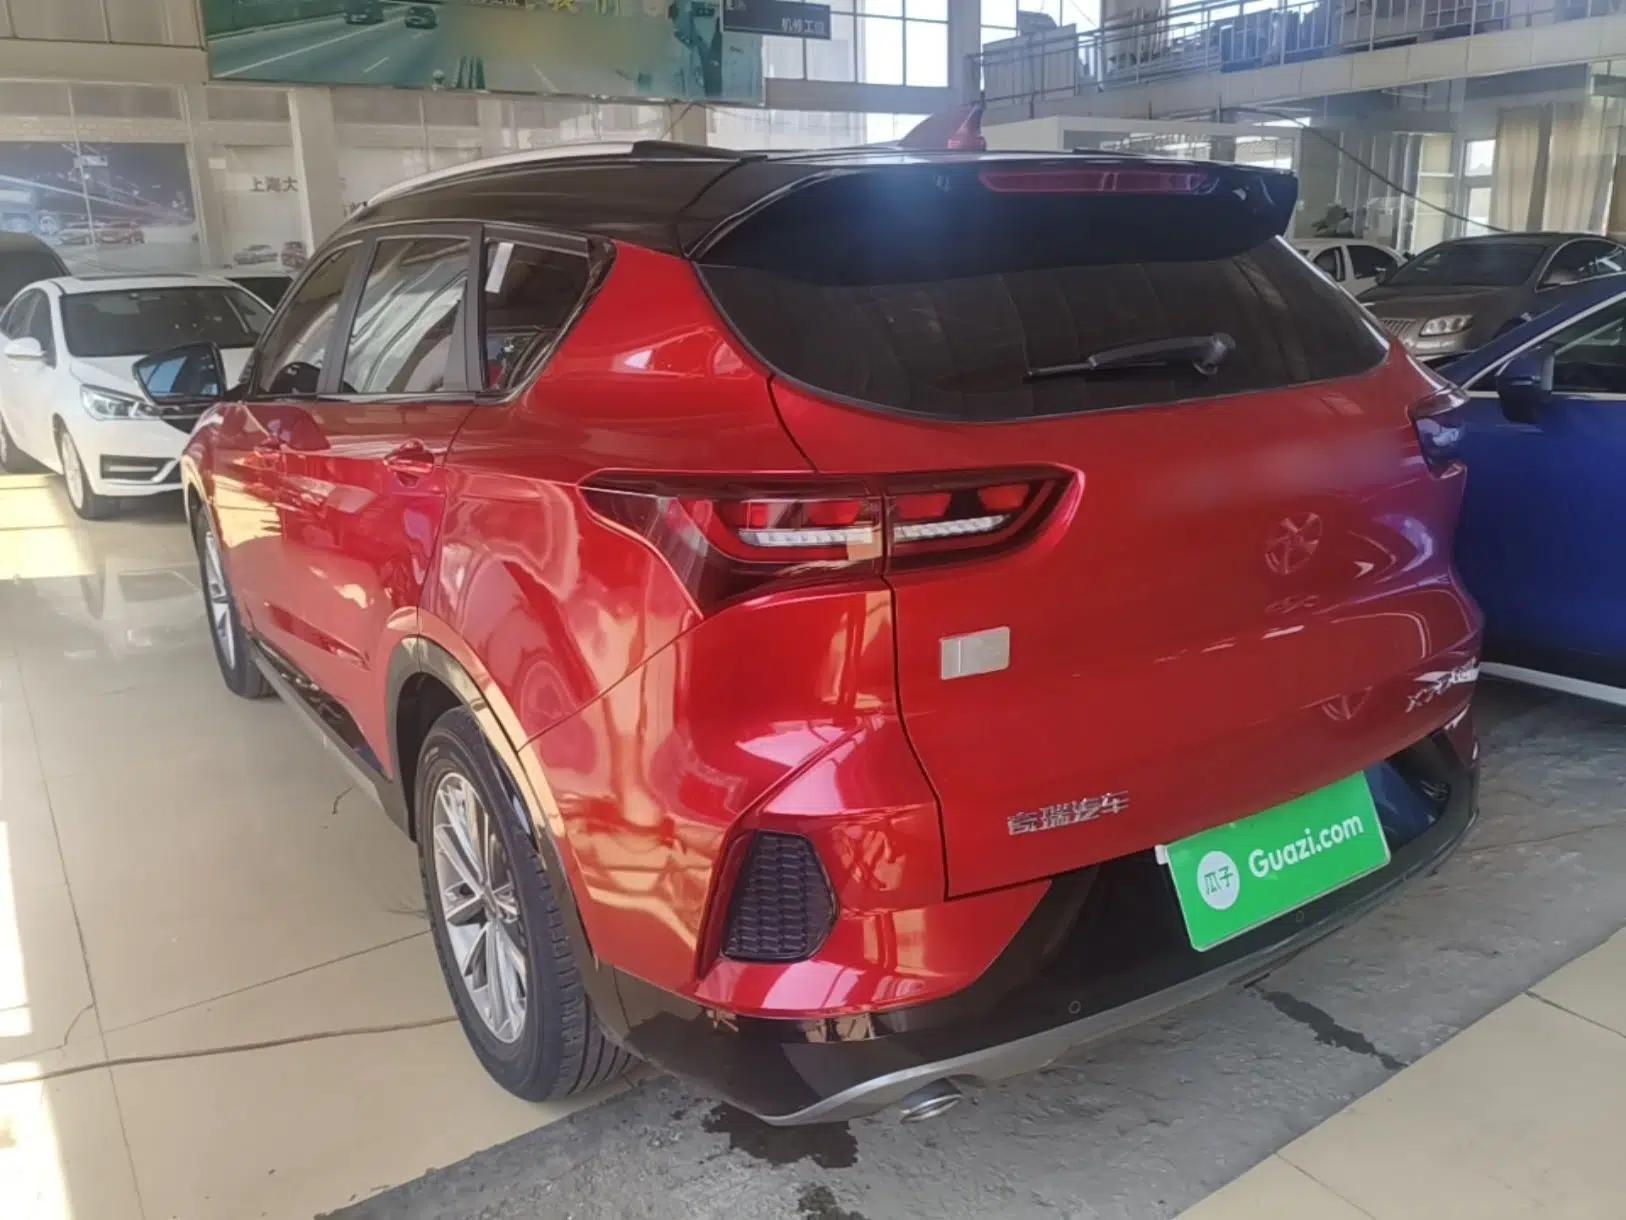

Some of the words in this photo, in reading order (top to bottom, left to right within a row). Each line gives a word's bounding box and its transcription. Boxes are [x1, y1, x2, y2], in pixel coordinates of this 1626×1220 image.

[1007, 790, 1130, 836] 奇瑞汽车
[1248, 815, 1365, 879] Guazi.com
[1204, 865, 1235, 896] 瓜子
